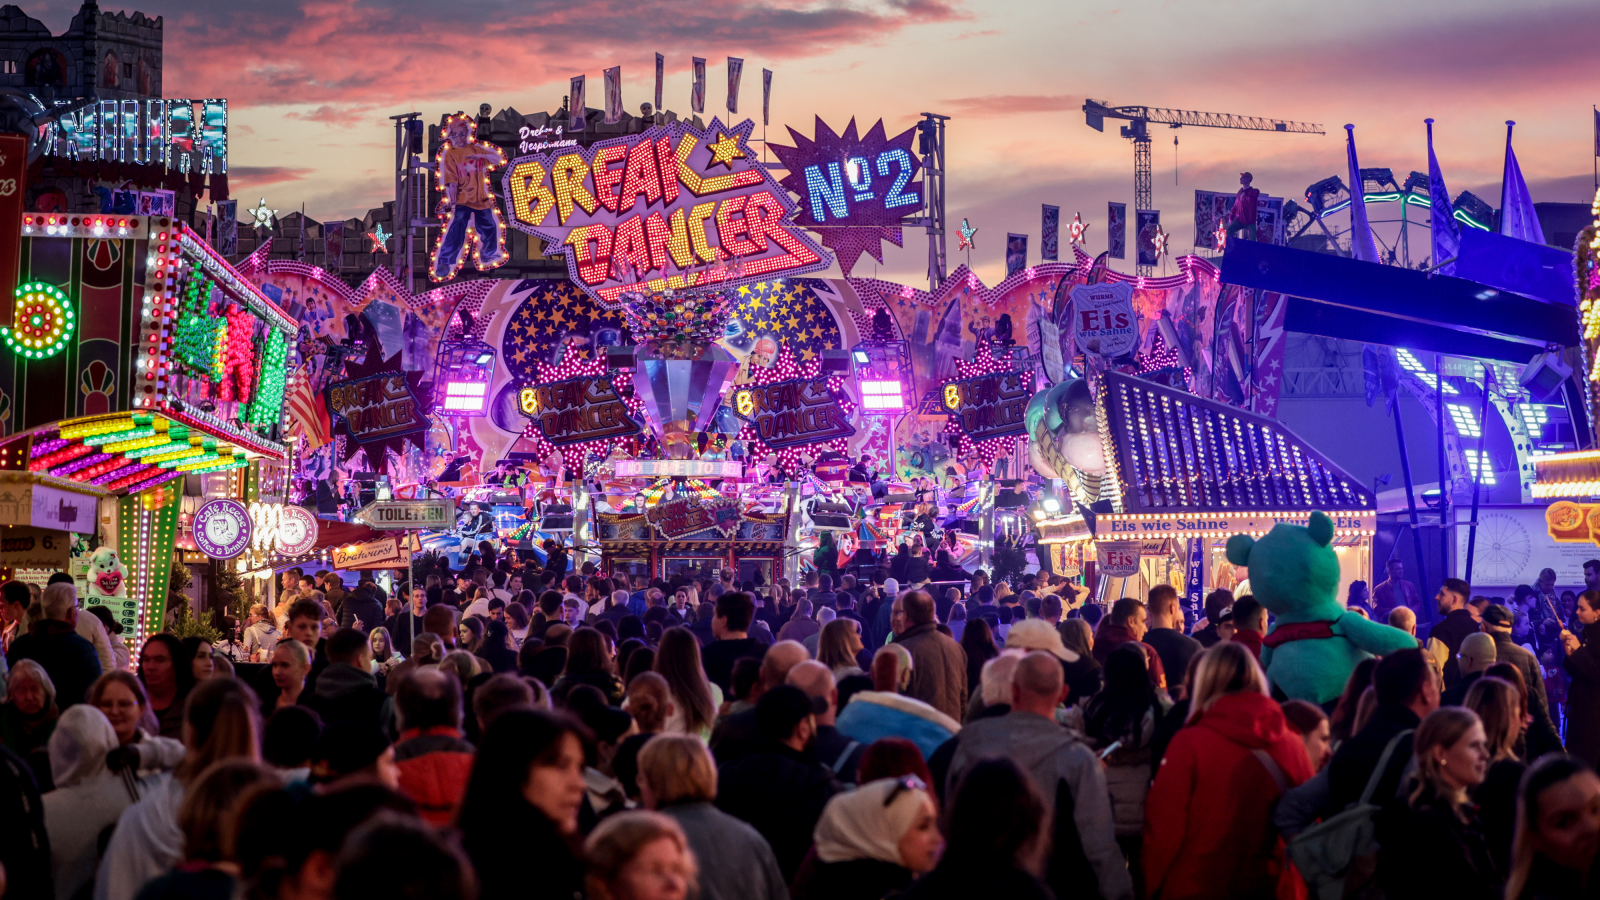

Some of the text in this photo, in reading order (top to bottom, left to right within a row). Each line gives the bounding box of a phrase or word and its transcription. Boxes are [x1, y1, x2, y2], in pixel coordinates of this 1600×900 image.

[555, 125, 563, 135] &
[509, 131, 766, 227] BREAK
[565, 190, 822, 288] DANCER
[1079, 327, 1132, 337] wie Sahne
[1080, 310, 1129, 331] Eis
[331, 377, 408, 411] BREAK
[520, 379, 617, 415] BREAK
[736, 381, 833, 416] BREAK
[944, 377, 1025, 409] BREAK
[346, 399, 429, 437] DANCER
[540, 400, 638, 438] DANCER
[756, 404, 850, 440] DANCER
[828, 466, 839, 474] 14
[199, 502, 219, 523] Café
[222, 502, 247, 528] Keese
[291, 509, 312, 530] Keese
[377, 508, 443, 521] TOILETTEN
[648, 500, 703, 523] BREAK
[661, 510, 714, 534] DANCER
[892, 511, 899, 519] 2
[1111, 520, 1137, 532] Eis
[1141, 519, 1171, 531] wie
[1176, 518, 1228, 530] Sahne
[197, 531, 247, 555] Coffee & Drinks
[1107, 551, 1133, 566] Eis
[1190, 560, 1200, 585] wie
